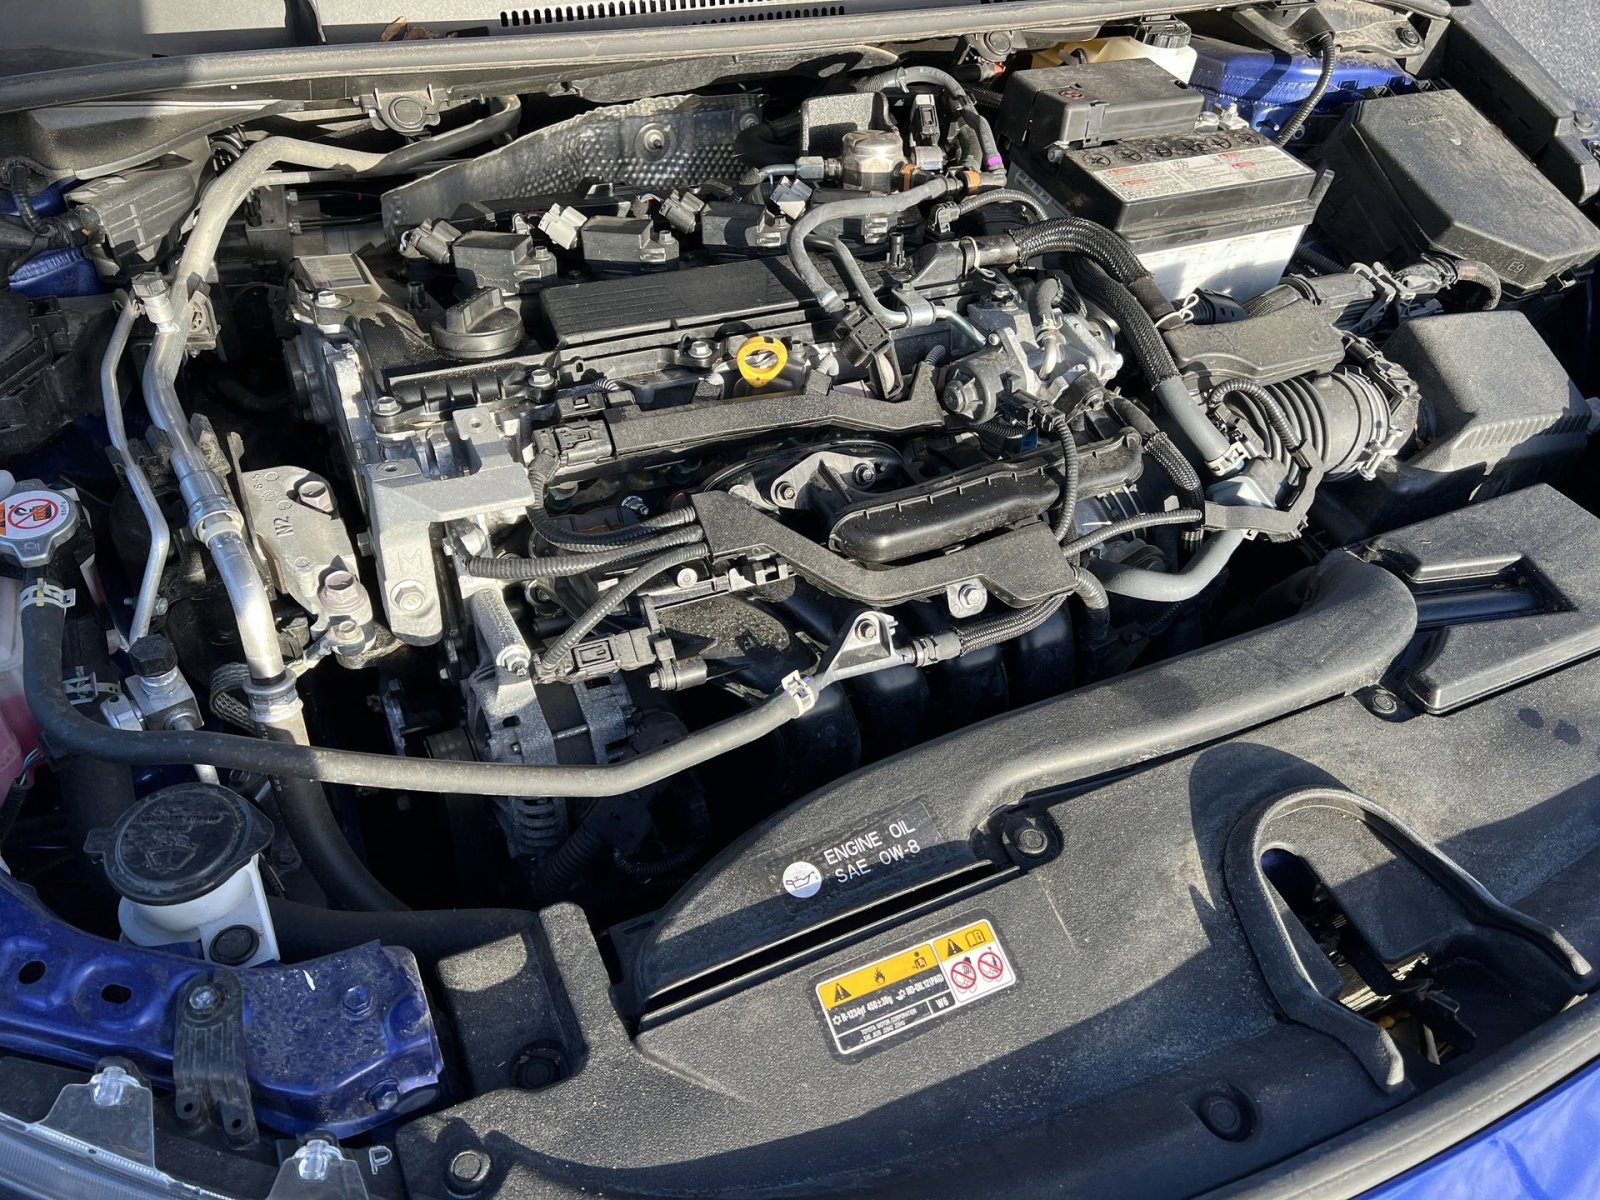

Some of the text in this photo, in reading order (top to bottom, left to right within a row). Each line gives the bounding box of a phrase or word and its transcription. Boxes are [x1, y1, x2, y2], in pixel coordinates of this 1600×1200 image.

[823, 819, 916, 865] ENGINE OIL
[834, 839, 921, 883] SAE 0W-8
[368, 1145, 393, 1175] P
